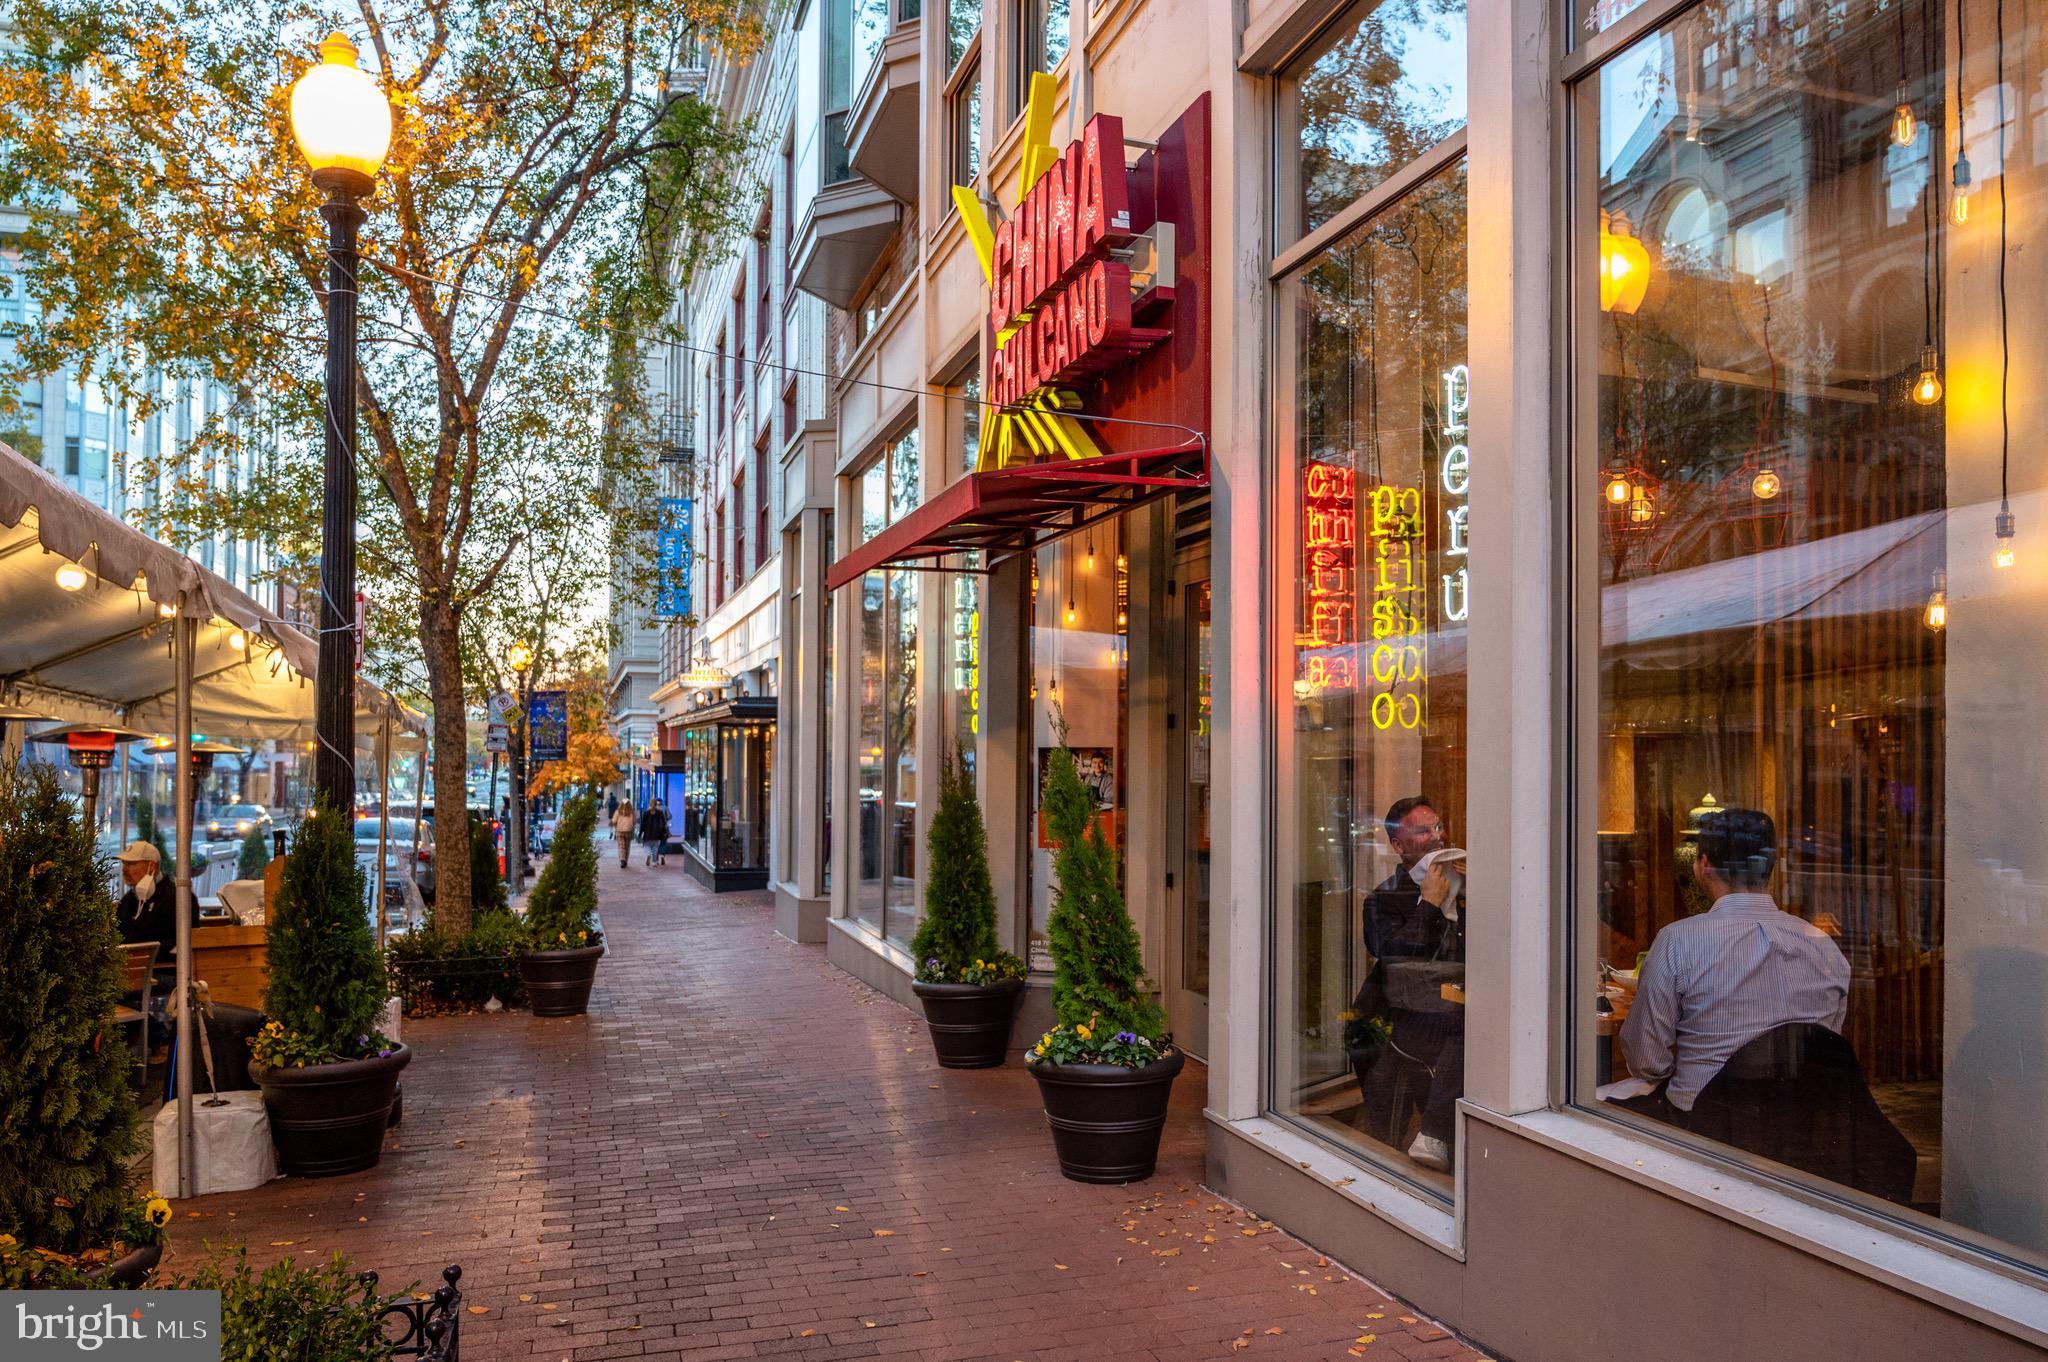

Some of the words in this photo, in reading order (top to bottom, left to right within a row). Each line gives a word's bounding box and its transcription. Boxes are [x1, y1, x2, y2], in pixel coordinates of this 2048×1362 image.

[991, 113, 1120, 334] CHINA
[991, 260, 1114, 416] CHILCANO
[1307, 464, 1333, 690] chifa
[1443, 364, 1468, 622] peru
[1369, 484, 1397, 730] pisco
